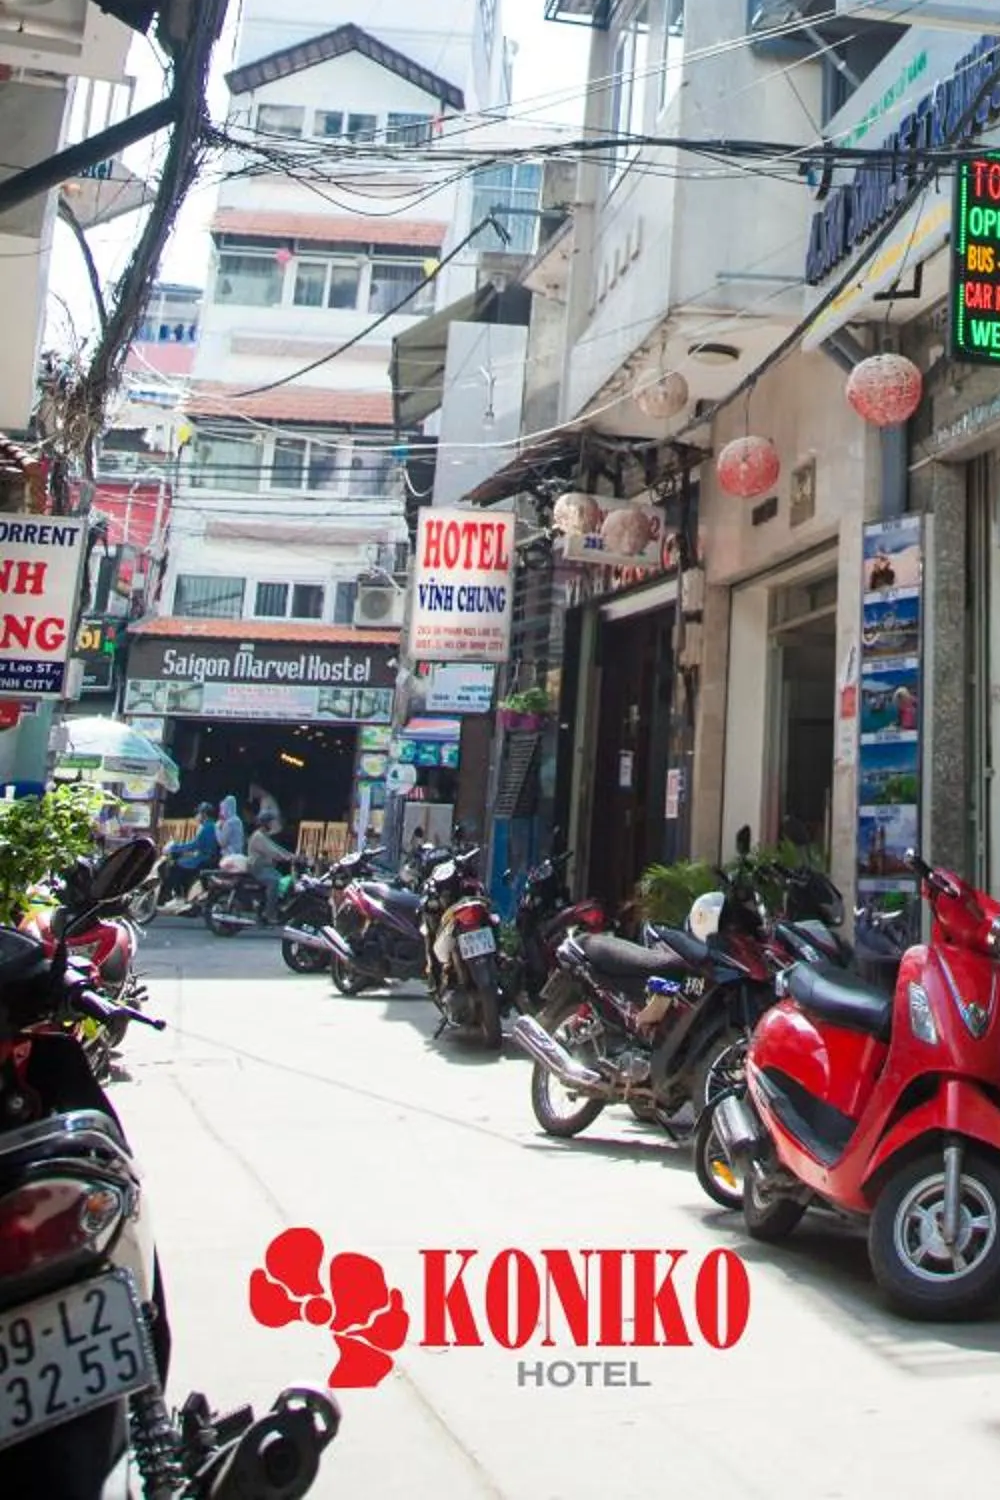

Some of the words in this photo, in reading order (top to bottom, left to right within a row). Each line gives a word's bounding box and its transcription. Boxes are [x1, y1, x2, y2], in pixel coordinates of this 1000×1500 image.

[967, 244, 994, 273] BUS
[965, 282, 992, 309] CAR
[423, 518, 509, 571] HOTEL
[457, 585, 507, 613] CHUNG
[163, 649, 230, 682] Saigon
[233, 651, 306, 680] Marvel
[308, 654, 371, 681] Hostel
[24, 679, 54, 690] CITY
[5, 1331, 138, 1428] 32.55
